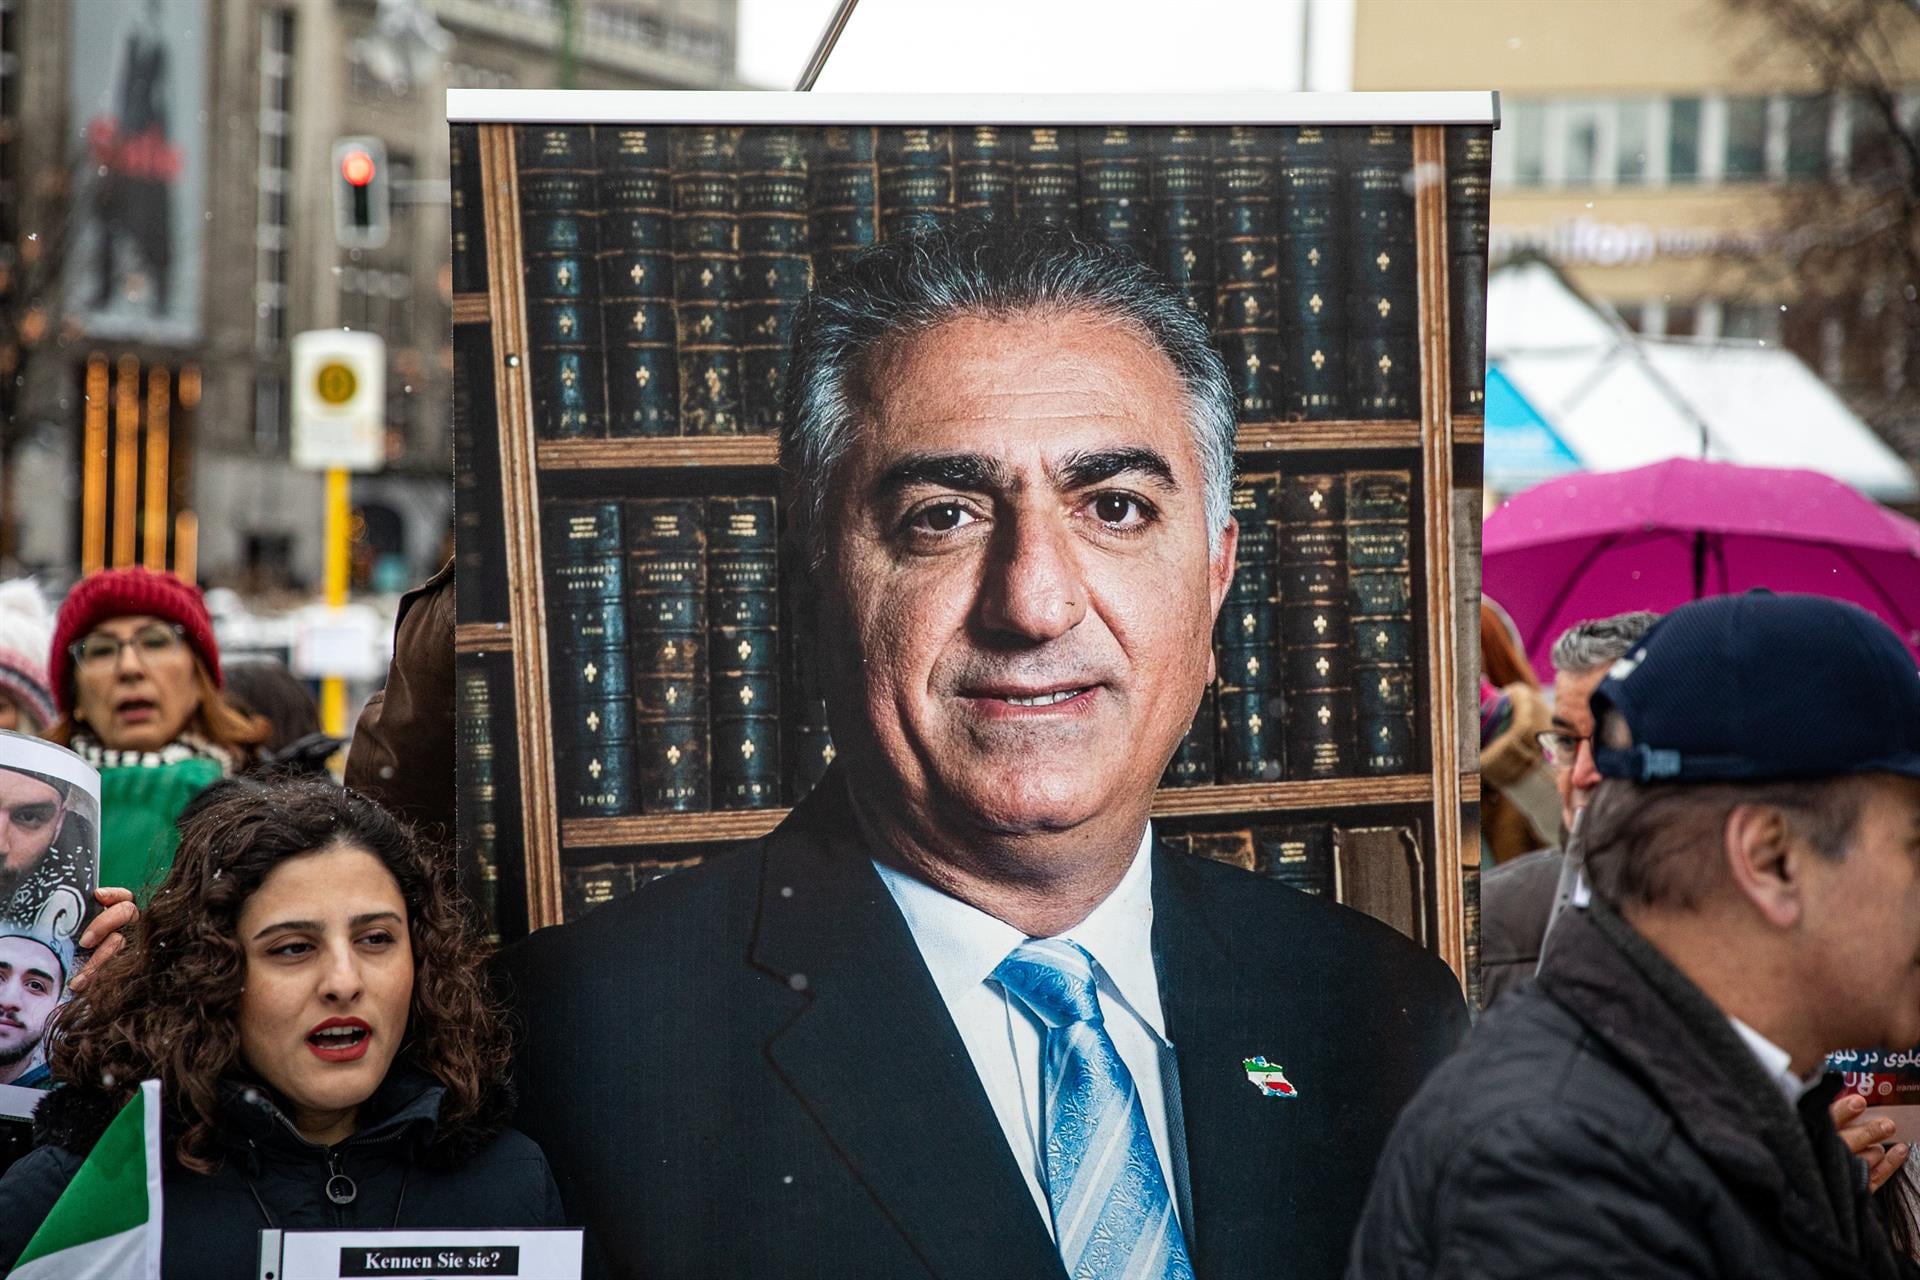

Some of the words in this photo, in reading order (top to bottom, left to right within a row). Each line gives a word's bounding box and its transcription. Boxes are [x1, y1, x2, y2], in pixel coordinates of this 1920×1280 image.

[365, 1252, 432, 1269] Kennen
[437, 1252, 463, 1268] Sie
[468, 1251, 500, 1268] sie?
